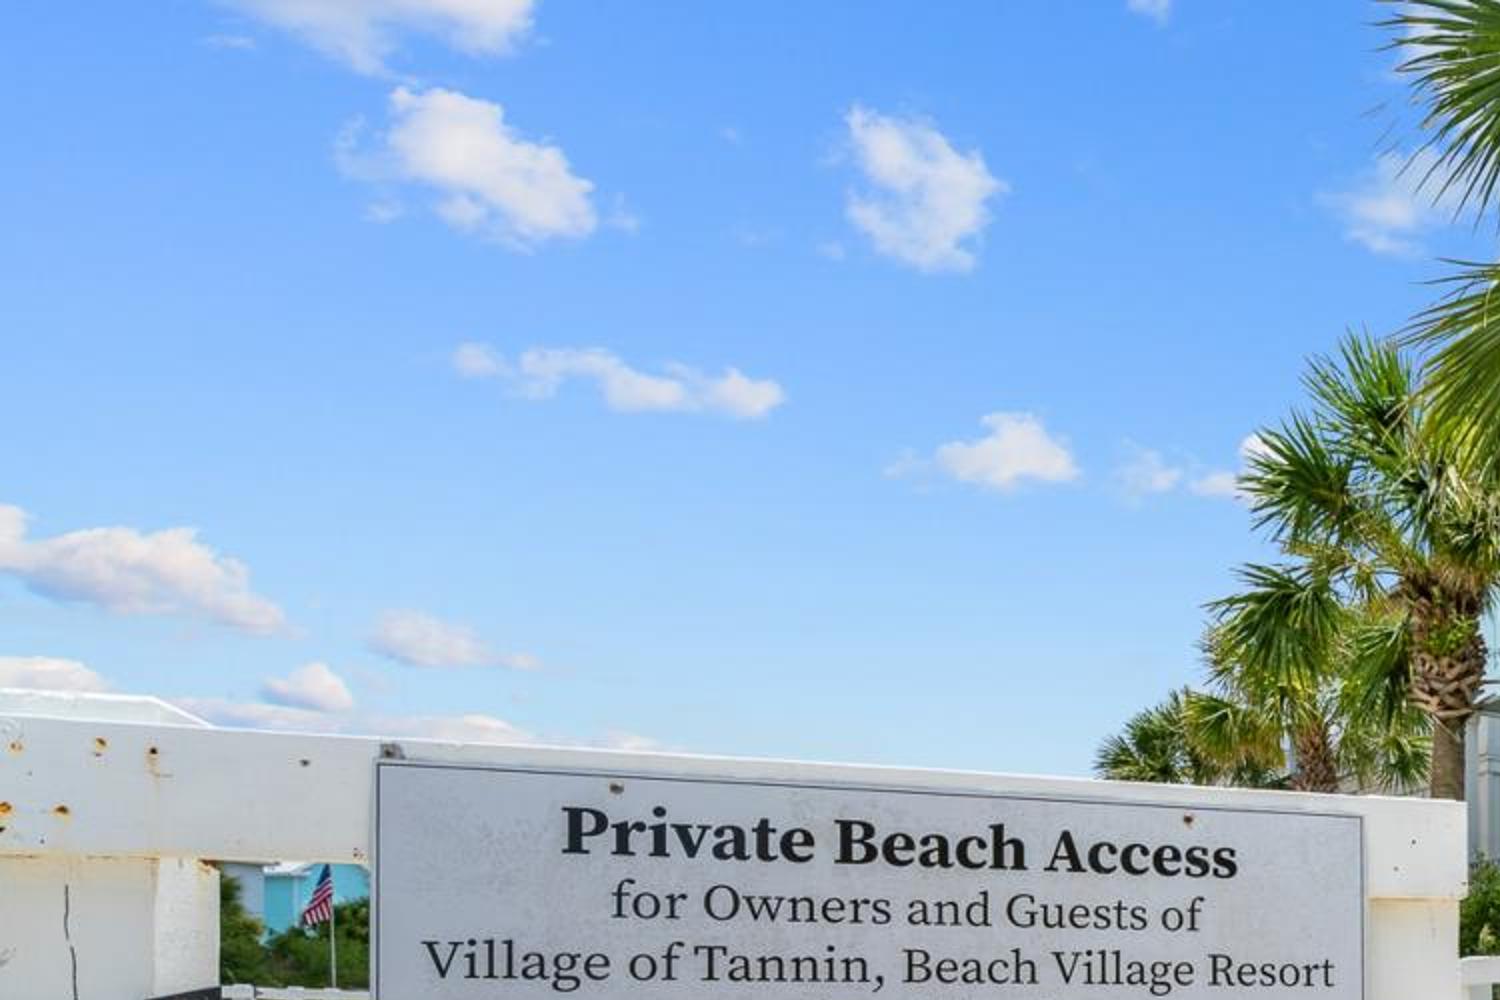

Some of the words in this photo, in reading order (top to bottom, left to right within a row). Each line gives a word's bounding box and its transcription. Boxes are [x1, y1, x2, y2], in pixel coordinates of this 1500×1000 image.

[561, 806, 815, 863] Private
[834, 819, 1028, 871] Beach
[1043, 830, 1238, 879] Access
[611, 878, 688, 920] for
[704, 885, 891, 924] Owners
[908, 890, 992, 927] and
[1006, 894, 1147, 930] Guests
[1161, 896, 1205, 932] of
[421, 938, 610, 992] Village
[629, 941, 685, 981] of
[694, 945, 884, 992] Tannin,
[902, 948, 1039, 984] Beach
[1051, 950, 1194, 996] Village
[1208, 954, 1335, 987] Resort
